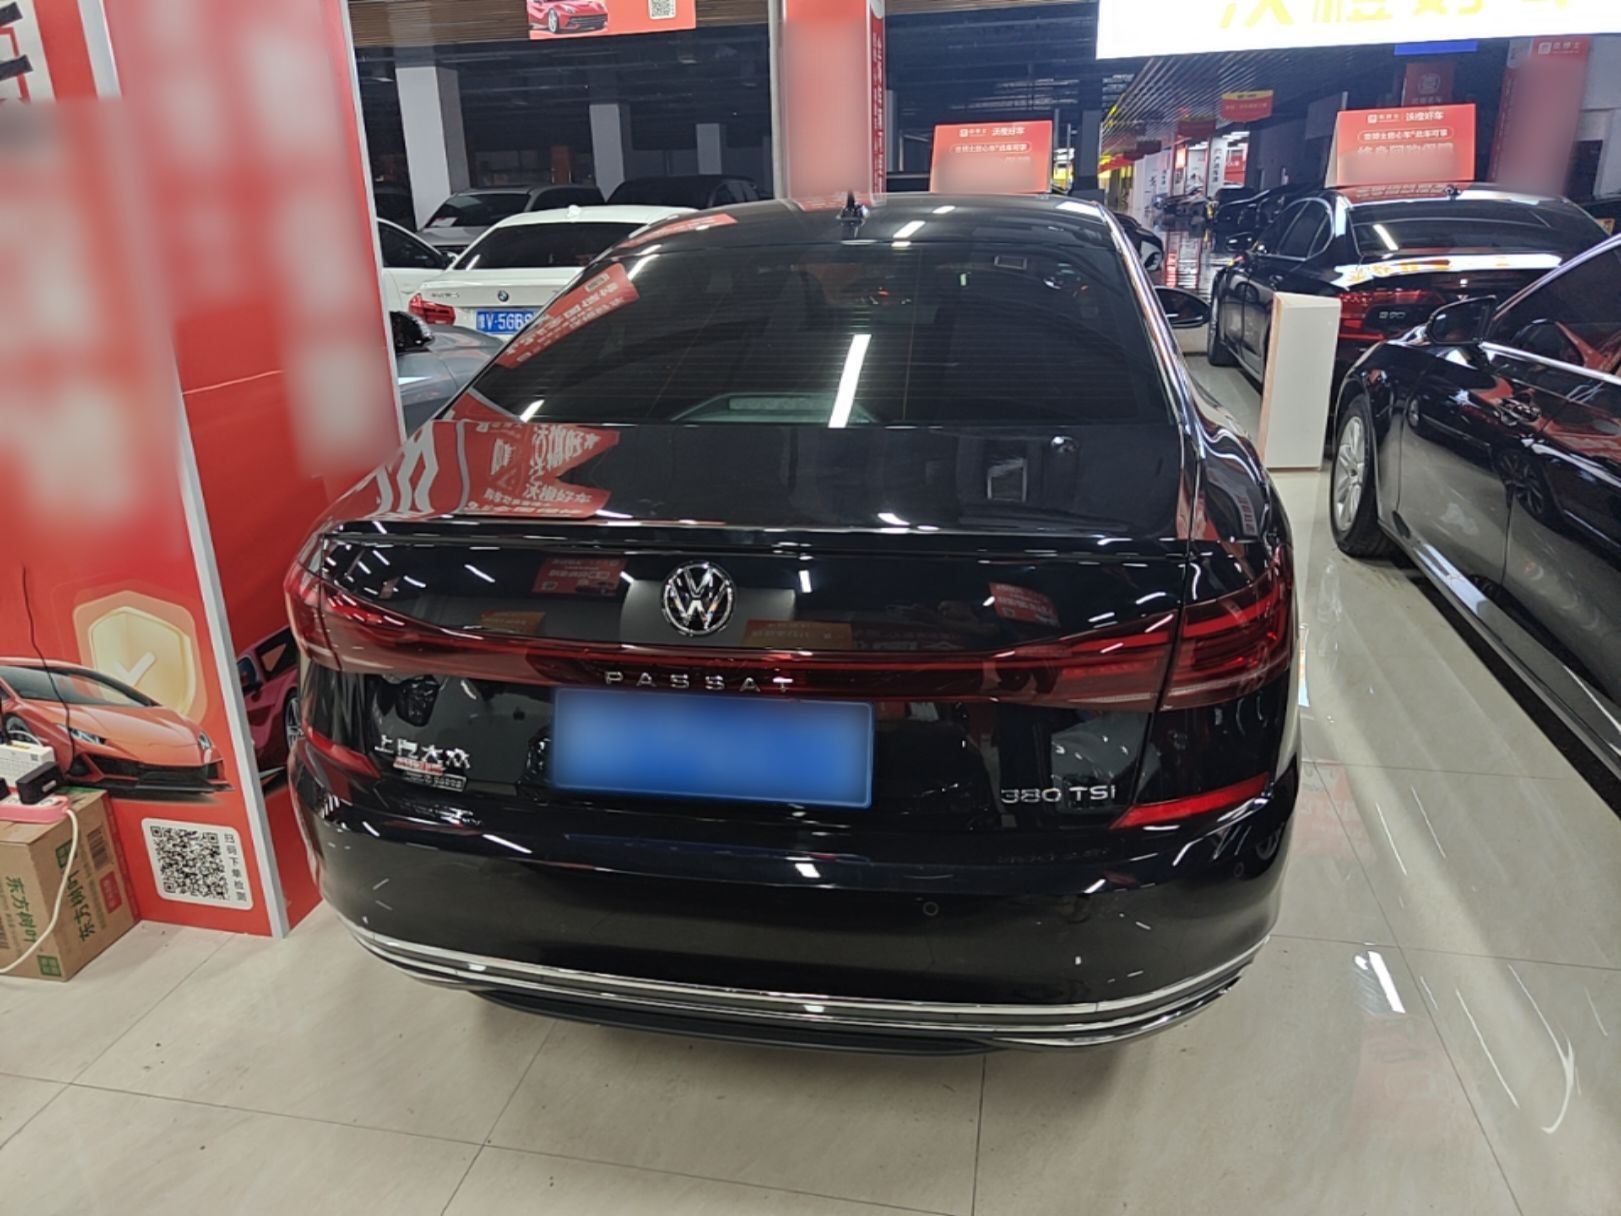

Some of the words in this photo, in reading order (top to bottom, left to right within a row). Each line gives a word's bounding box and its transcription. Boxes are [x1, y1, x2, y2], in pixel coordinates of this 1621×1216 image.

[605, 671, 794, 693] PASSAT
[374, 734, 470, 769] 上汽大众
[6, 876, 37, 943] 东方树叶
